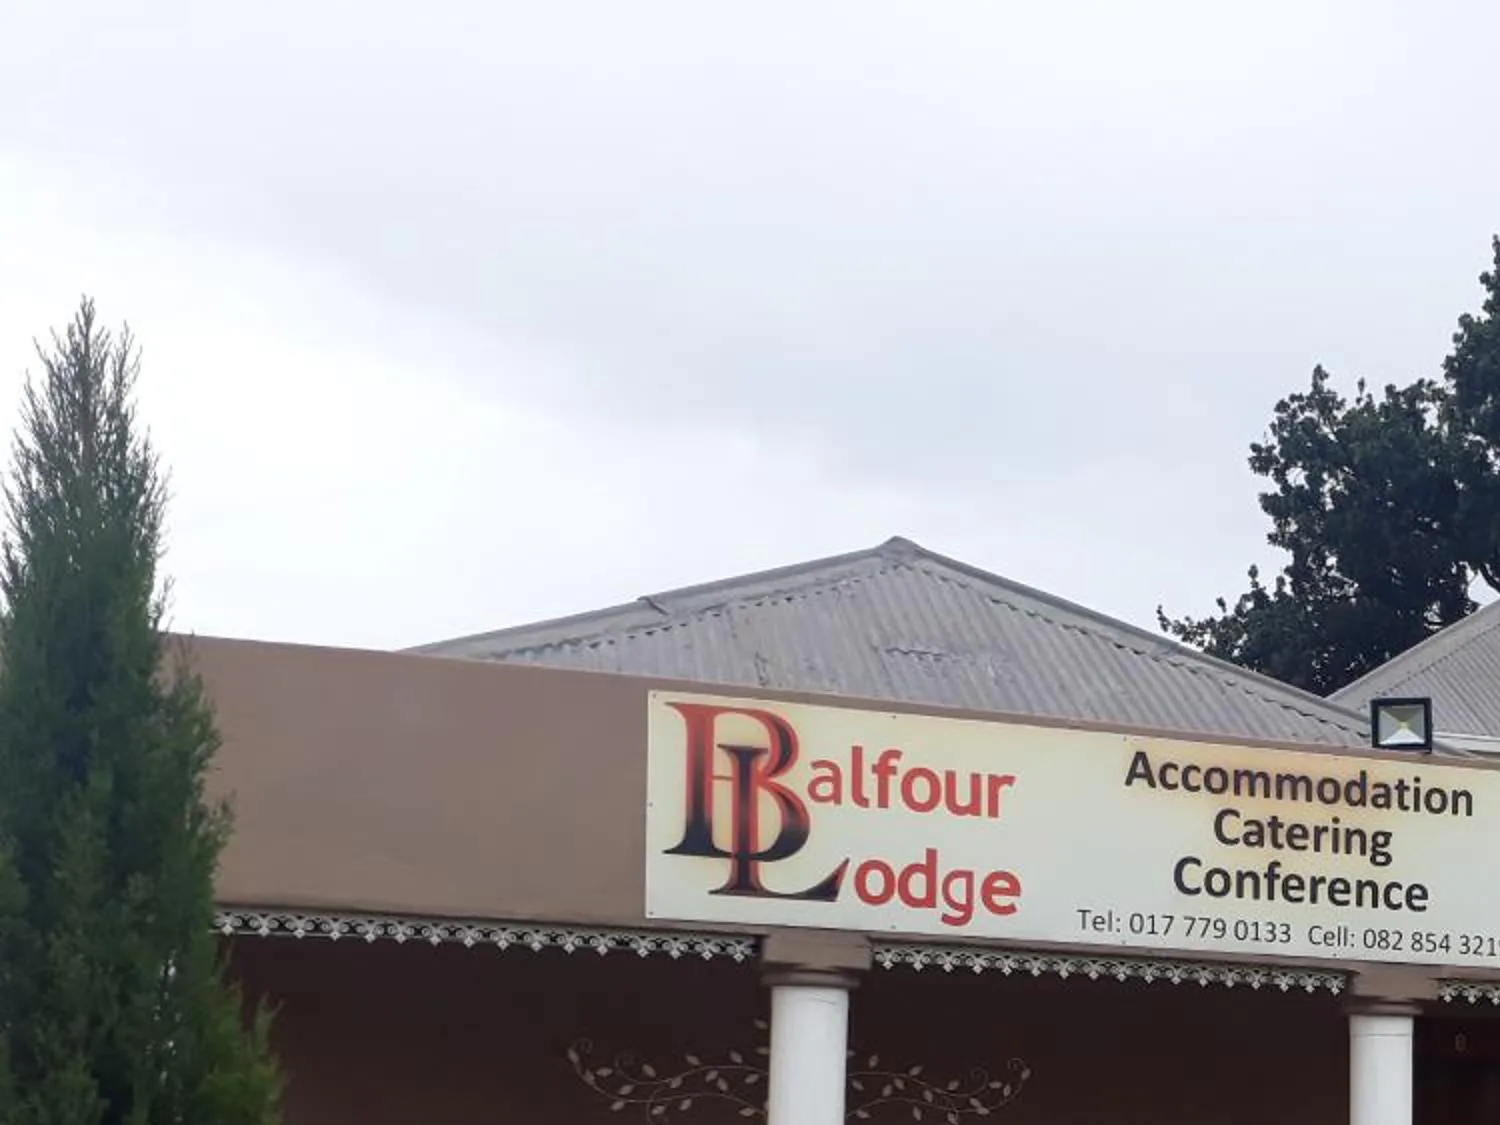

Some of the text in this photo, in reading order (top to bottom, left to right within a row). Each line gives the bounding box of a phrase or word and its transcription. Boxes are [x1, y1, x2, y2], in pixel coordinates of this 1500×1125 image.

[662, 702, 1016, 862] Balfour
[1124, 751, 1474, 817] Accommodation
[708, 744, 1023, 927] Lodge
[1213, 808, 1393, 867] Catering
[1173, 856, 1430, 912] Conference
[1077, 909, 1122, 934] Tel:
[1129, 912, 1175, 936] 017
[1183, 916, 1227, 939] 779
[1233, 919, 1292, 943] 0133
[1308, 925, 1355, 948] Cell:
[1363, 928, 1403, 951] 082
[1410, 932, 1452, 954] 854
